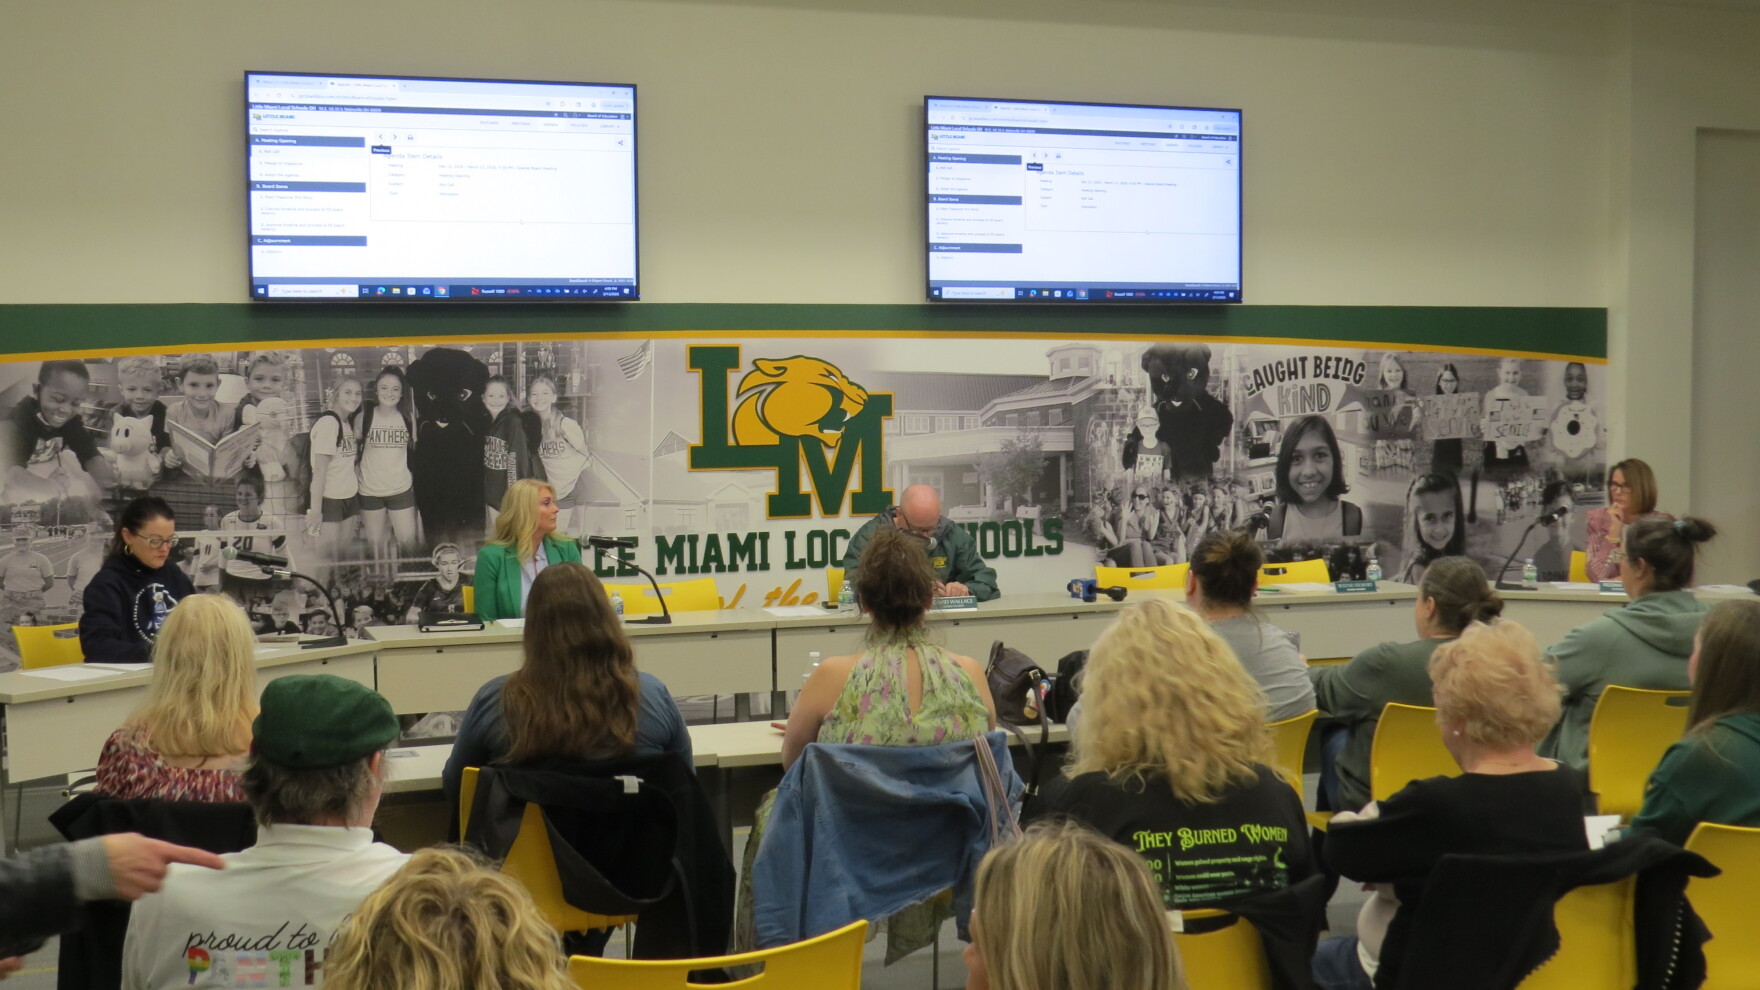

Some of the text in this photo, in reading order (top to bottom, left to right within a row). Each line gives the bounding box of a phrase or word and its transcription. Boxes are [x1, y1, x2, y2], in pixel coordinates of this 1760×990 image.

[1243, 356, 1308, 398] CAUGHT
[655, 531, 771, 577] MIAMI
[784, 528, 851, 570] LOC
[182, 920, 320, 958] proud to
